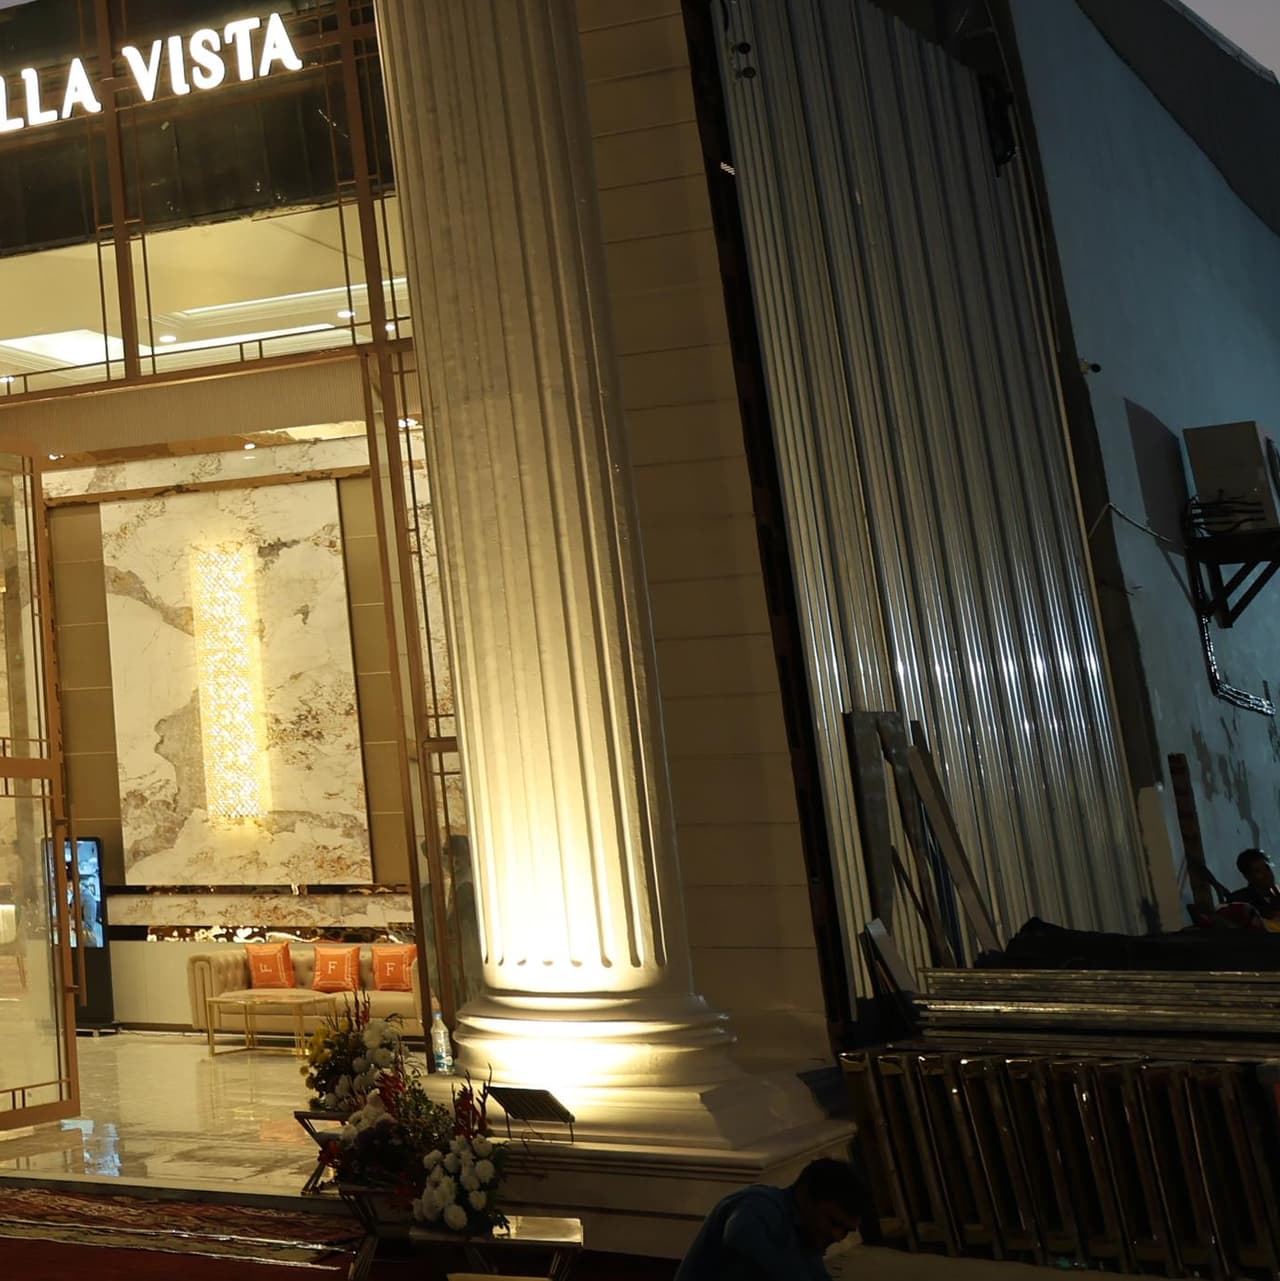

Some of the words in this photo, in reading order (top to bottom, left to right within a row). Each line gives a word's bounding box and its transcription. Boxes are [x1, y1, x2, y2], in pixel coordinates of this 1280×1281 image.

[122, 13, 303, 102] VISTA
[328, 961, 338, 975] F
[386, 963, 396, 976] F
